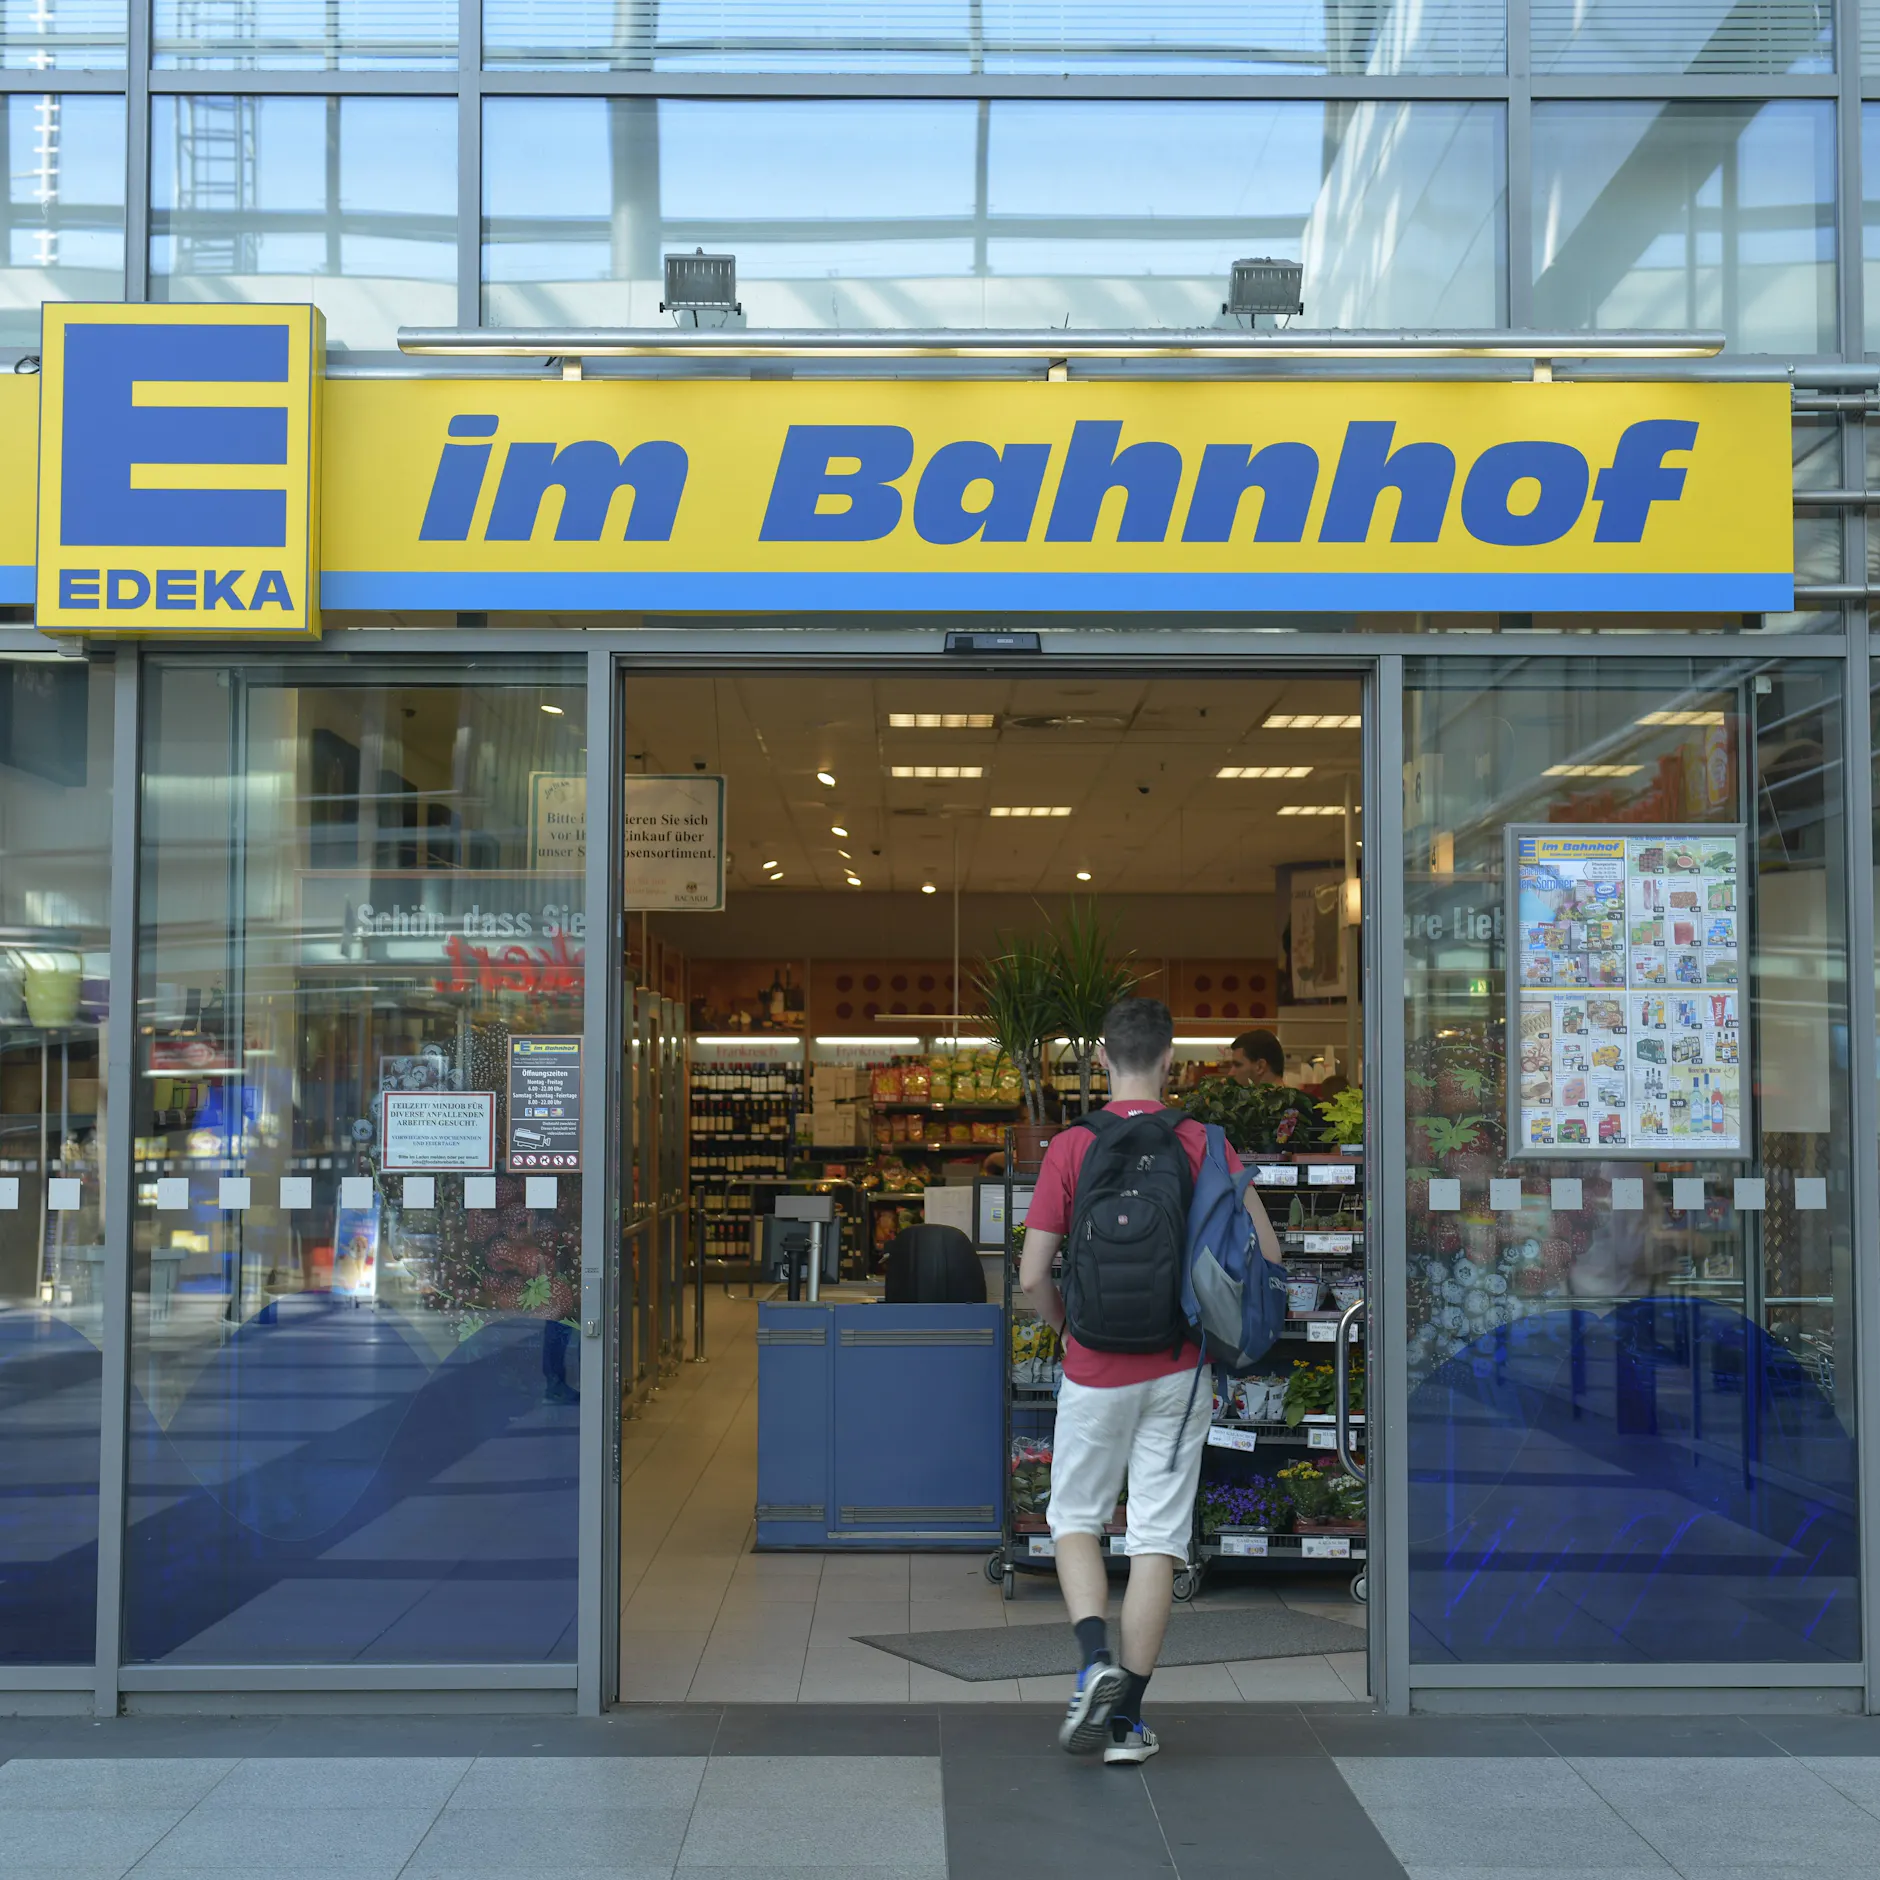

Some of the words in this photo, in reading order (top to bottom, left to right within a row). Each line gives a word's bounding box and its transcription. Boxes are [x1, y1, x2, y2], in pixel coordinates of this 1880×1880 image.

[60, 324, 289, 547] E
[418, 414, 690, 542] im
[758, 418, 1700, 547] Bahnhof
[58, 569, 294, 611] EDEKA
[547, 812, 576, 824] Bitte
[661, 813, 680, 825] Sie
[684, 814, 708, 826] sich
[550, 831, 571, 841] vor
[675, 831, 704, 842] über
[538, 848, 573, 857] unser
[1542, 842, 1558, 851] im
[1563, 842, 1620, 851] Bahnhof
[1536, 876, 1573, 890] Sommer
[463, 904, 532, 937] dass
[542, 904, 586, 938] Sie
[715, 1045, 778, 1058] Frankreich
[522, 1069, 568, 1078] Öffnungszeiten
[468, 1101, 484, 1109] FÜR
[426, 1111, 485, 1119] ANFALLENDEN
